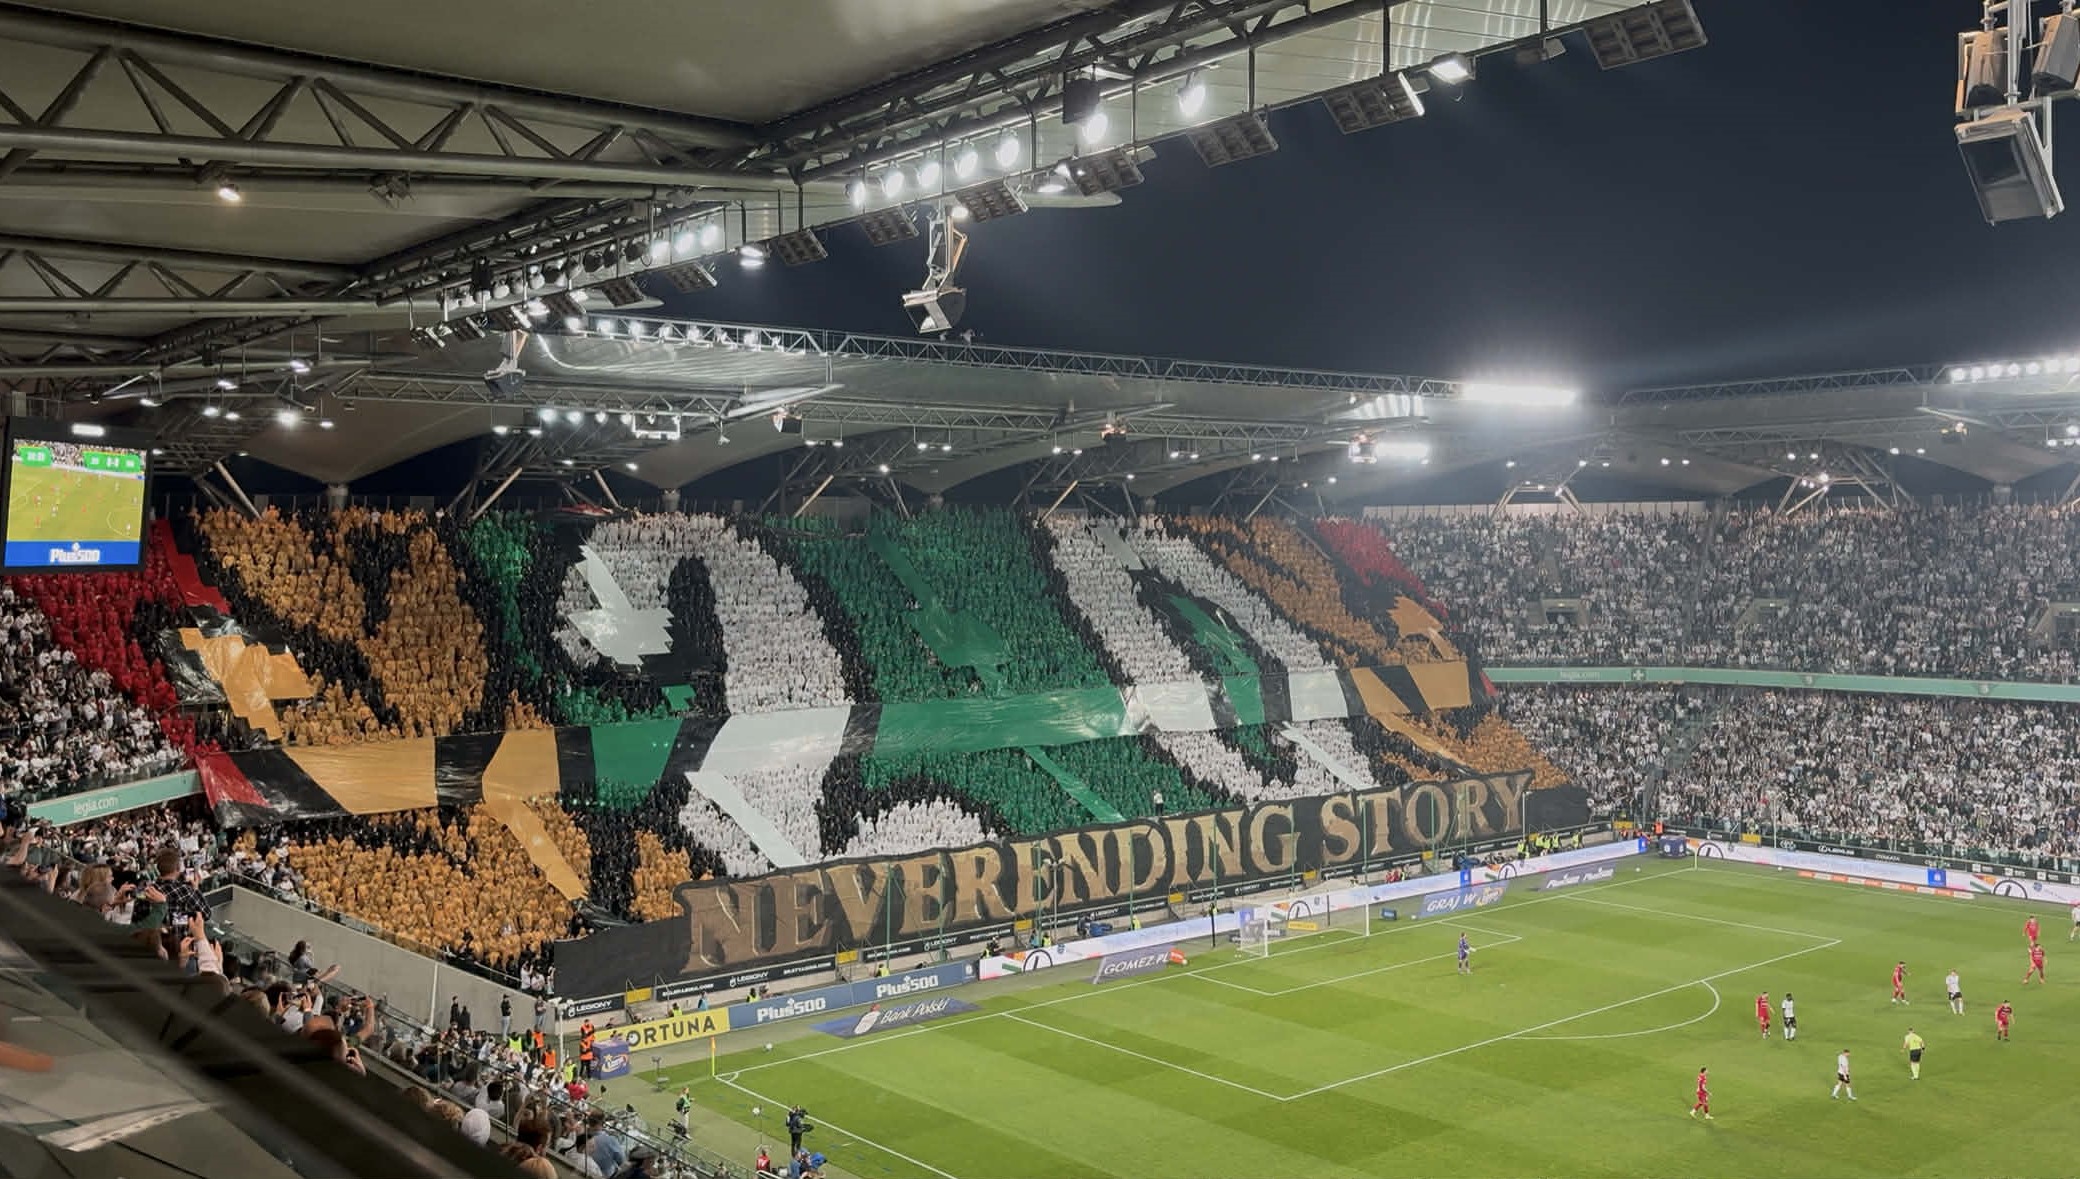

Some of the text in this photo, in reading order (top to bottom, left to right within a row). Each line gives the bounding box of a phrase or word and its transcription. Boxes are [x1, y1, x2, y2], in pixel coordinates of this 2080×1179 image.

[73, 796, 118, 816] legia.com
[680, 774, 1530, 972] NEVERENDING STORY
[1427, 896, 1460, 912] GRAJ
[1463, 893, 1477, 905] W
[1104, 952, 1169, 974] GOMEZ.PL
[876, 975, 938, 998] Plus500
[576, 1000, 612, 1012] LEGIONY
[757, 998, 826, 1023] Plus500
[880, 997, 950, 1024] Bank Polski
[610, 1016, 716, 1047] ORTUNA
